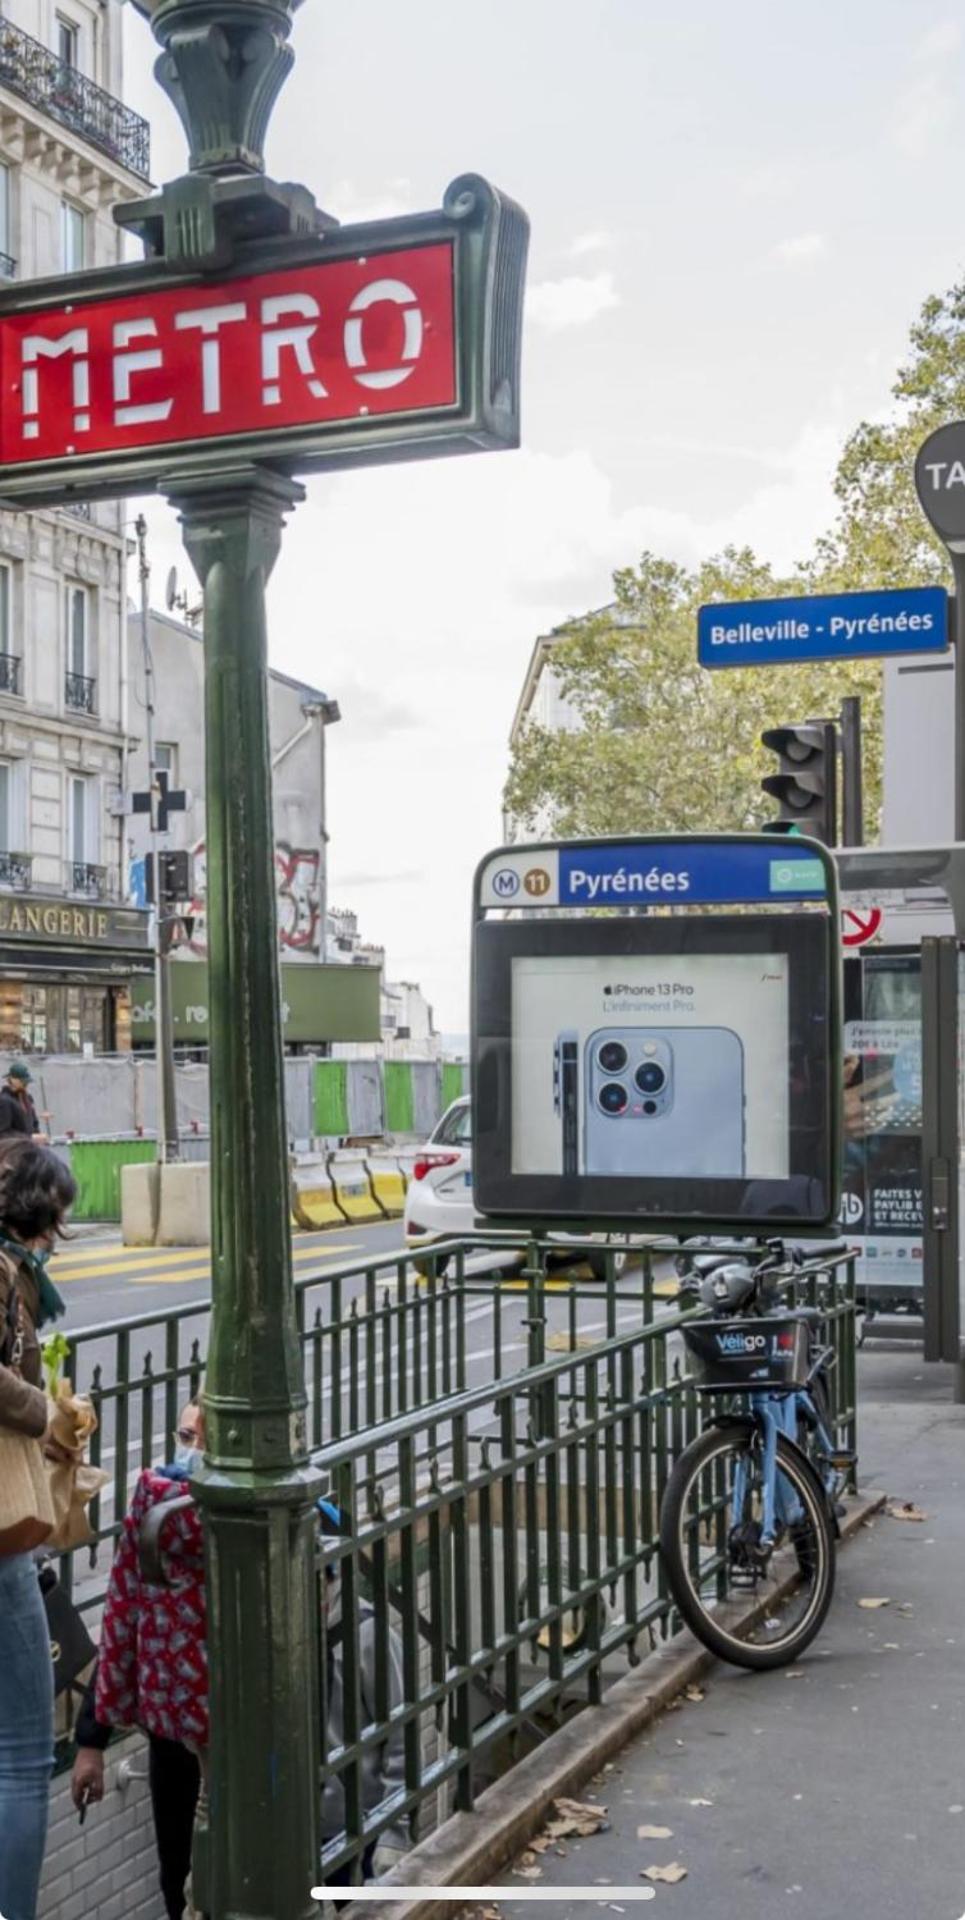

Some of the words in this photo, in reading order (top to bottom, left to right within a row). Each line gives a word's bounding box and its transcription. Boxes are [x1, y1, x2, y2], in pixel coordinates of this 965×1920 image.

[22, 278, 423, 440] METRO
[925, 461, 965, 490] TA
[711, 620, 810, 645] Belleville
[830, 611, 933, 640] Pyrénées
[569, 867, 690, 898] Pyrénées
[614, 983, 655, 996] iPhone
[657, 983, 670, 995] 13
[673, 983, 694, 996] Pro
[874, 1189, 912, 1199] FAITES
[874, 1200, 913, 1210] PAYLIB
[874, 1211, 887, 1220] ET
[715, 1333, 766, 1352] Véligo
